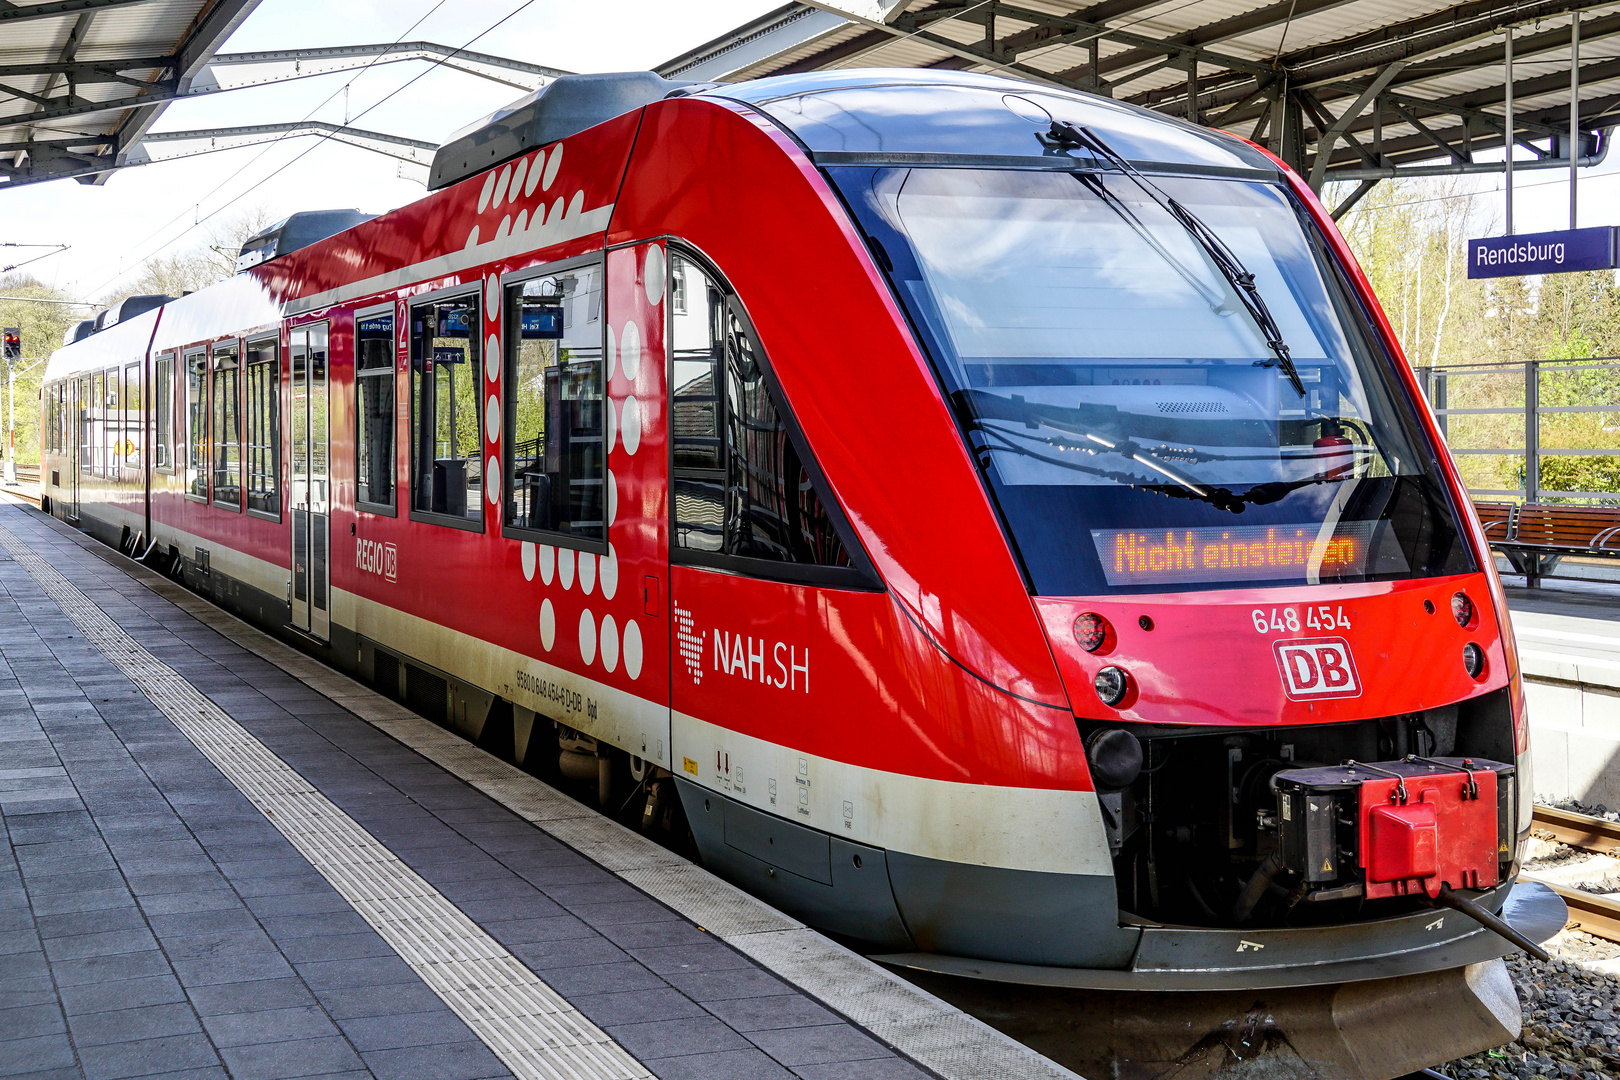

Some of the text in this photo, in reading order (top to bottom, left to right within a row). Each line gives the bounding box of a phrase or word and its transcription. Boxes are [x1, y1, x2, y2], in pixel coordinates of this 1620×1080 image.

[1477, 242, 1565, 266] Rendsburg
[399, 303, 407, 349] 2
[356, 537, 397, 580] REGIO DB
[1117, 528, 1354, 572] Nicht einsteigen
[1251, 605, 1351, 635] 648 454
[714, 628, 809, 694] NAH.SH
[1282, 645, 1353, 692] DB
[536, 678, 547, 698] 648
